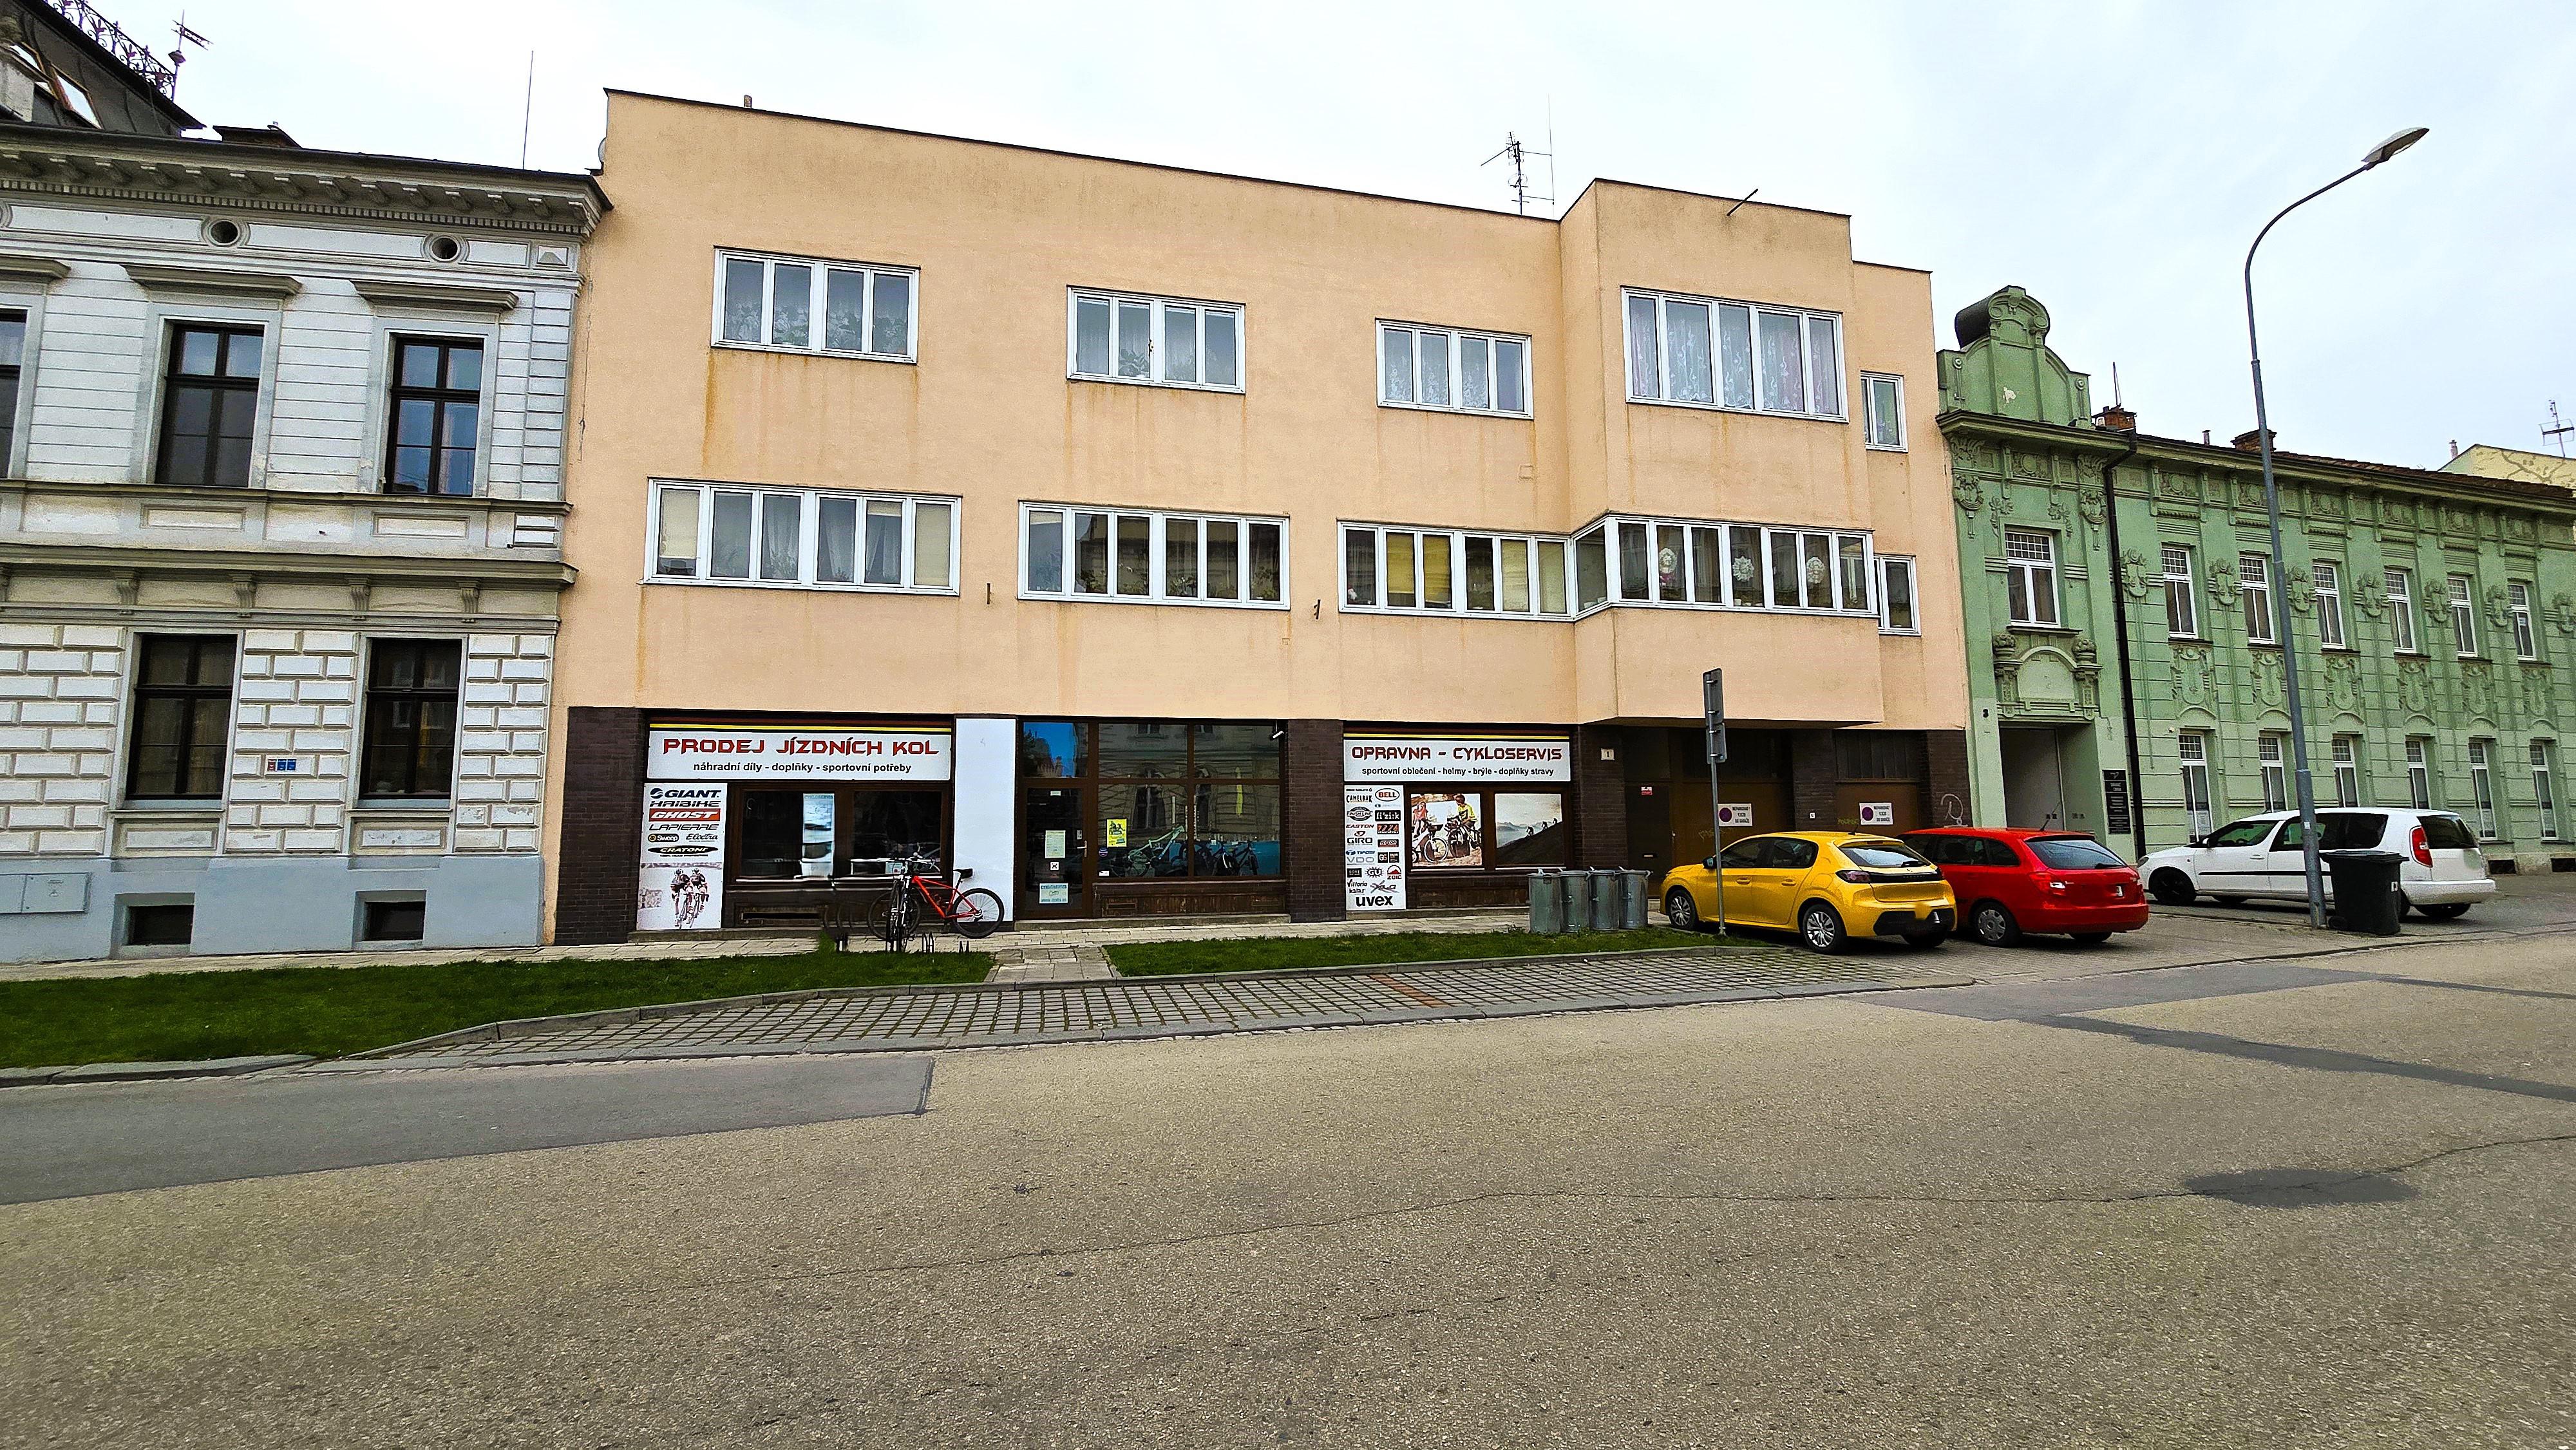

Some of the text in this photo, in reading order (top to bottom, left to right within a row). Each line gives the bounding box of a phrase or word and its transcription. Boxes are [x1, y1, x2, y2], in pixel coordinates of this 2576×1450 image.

[663, 737, 940, 756] PRODEJ JÍZDNÍCH KOL
[1352, 746, 1431, 760] OPRAVNA
[1453, 746, 1562, 761] CYKLOSERVIS
[694, 762, 740, 771] náhradní
[743, 762, 762, 772] díly
[772, 762, 813, 773] doplňky
[822, 763, 871, 773] sportovní
[874, 763, 912, 773] potřeby
[1361, 767, 1401, 775] sportovní
[1443, 767, 1466, 776] helmy
[1473, 767, 1492, 776] brýle
[1499, 767, 1529, 776] doplňky
[650, 811, 718, 819] GHOST
[1356, 896, 1393, 907] uvex
